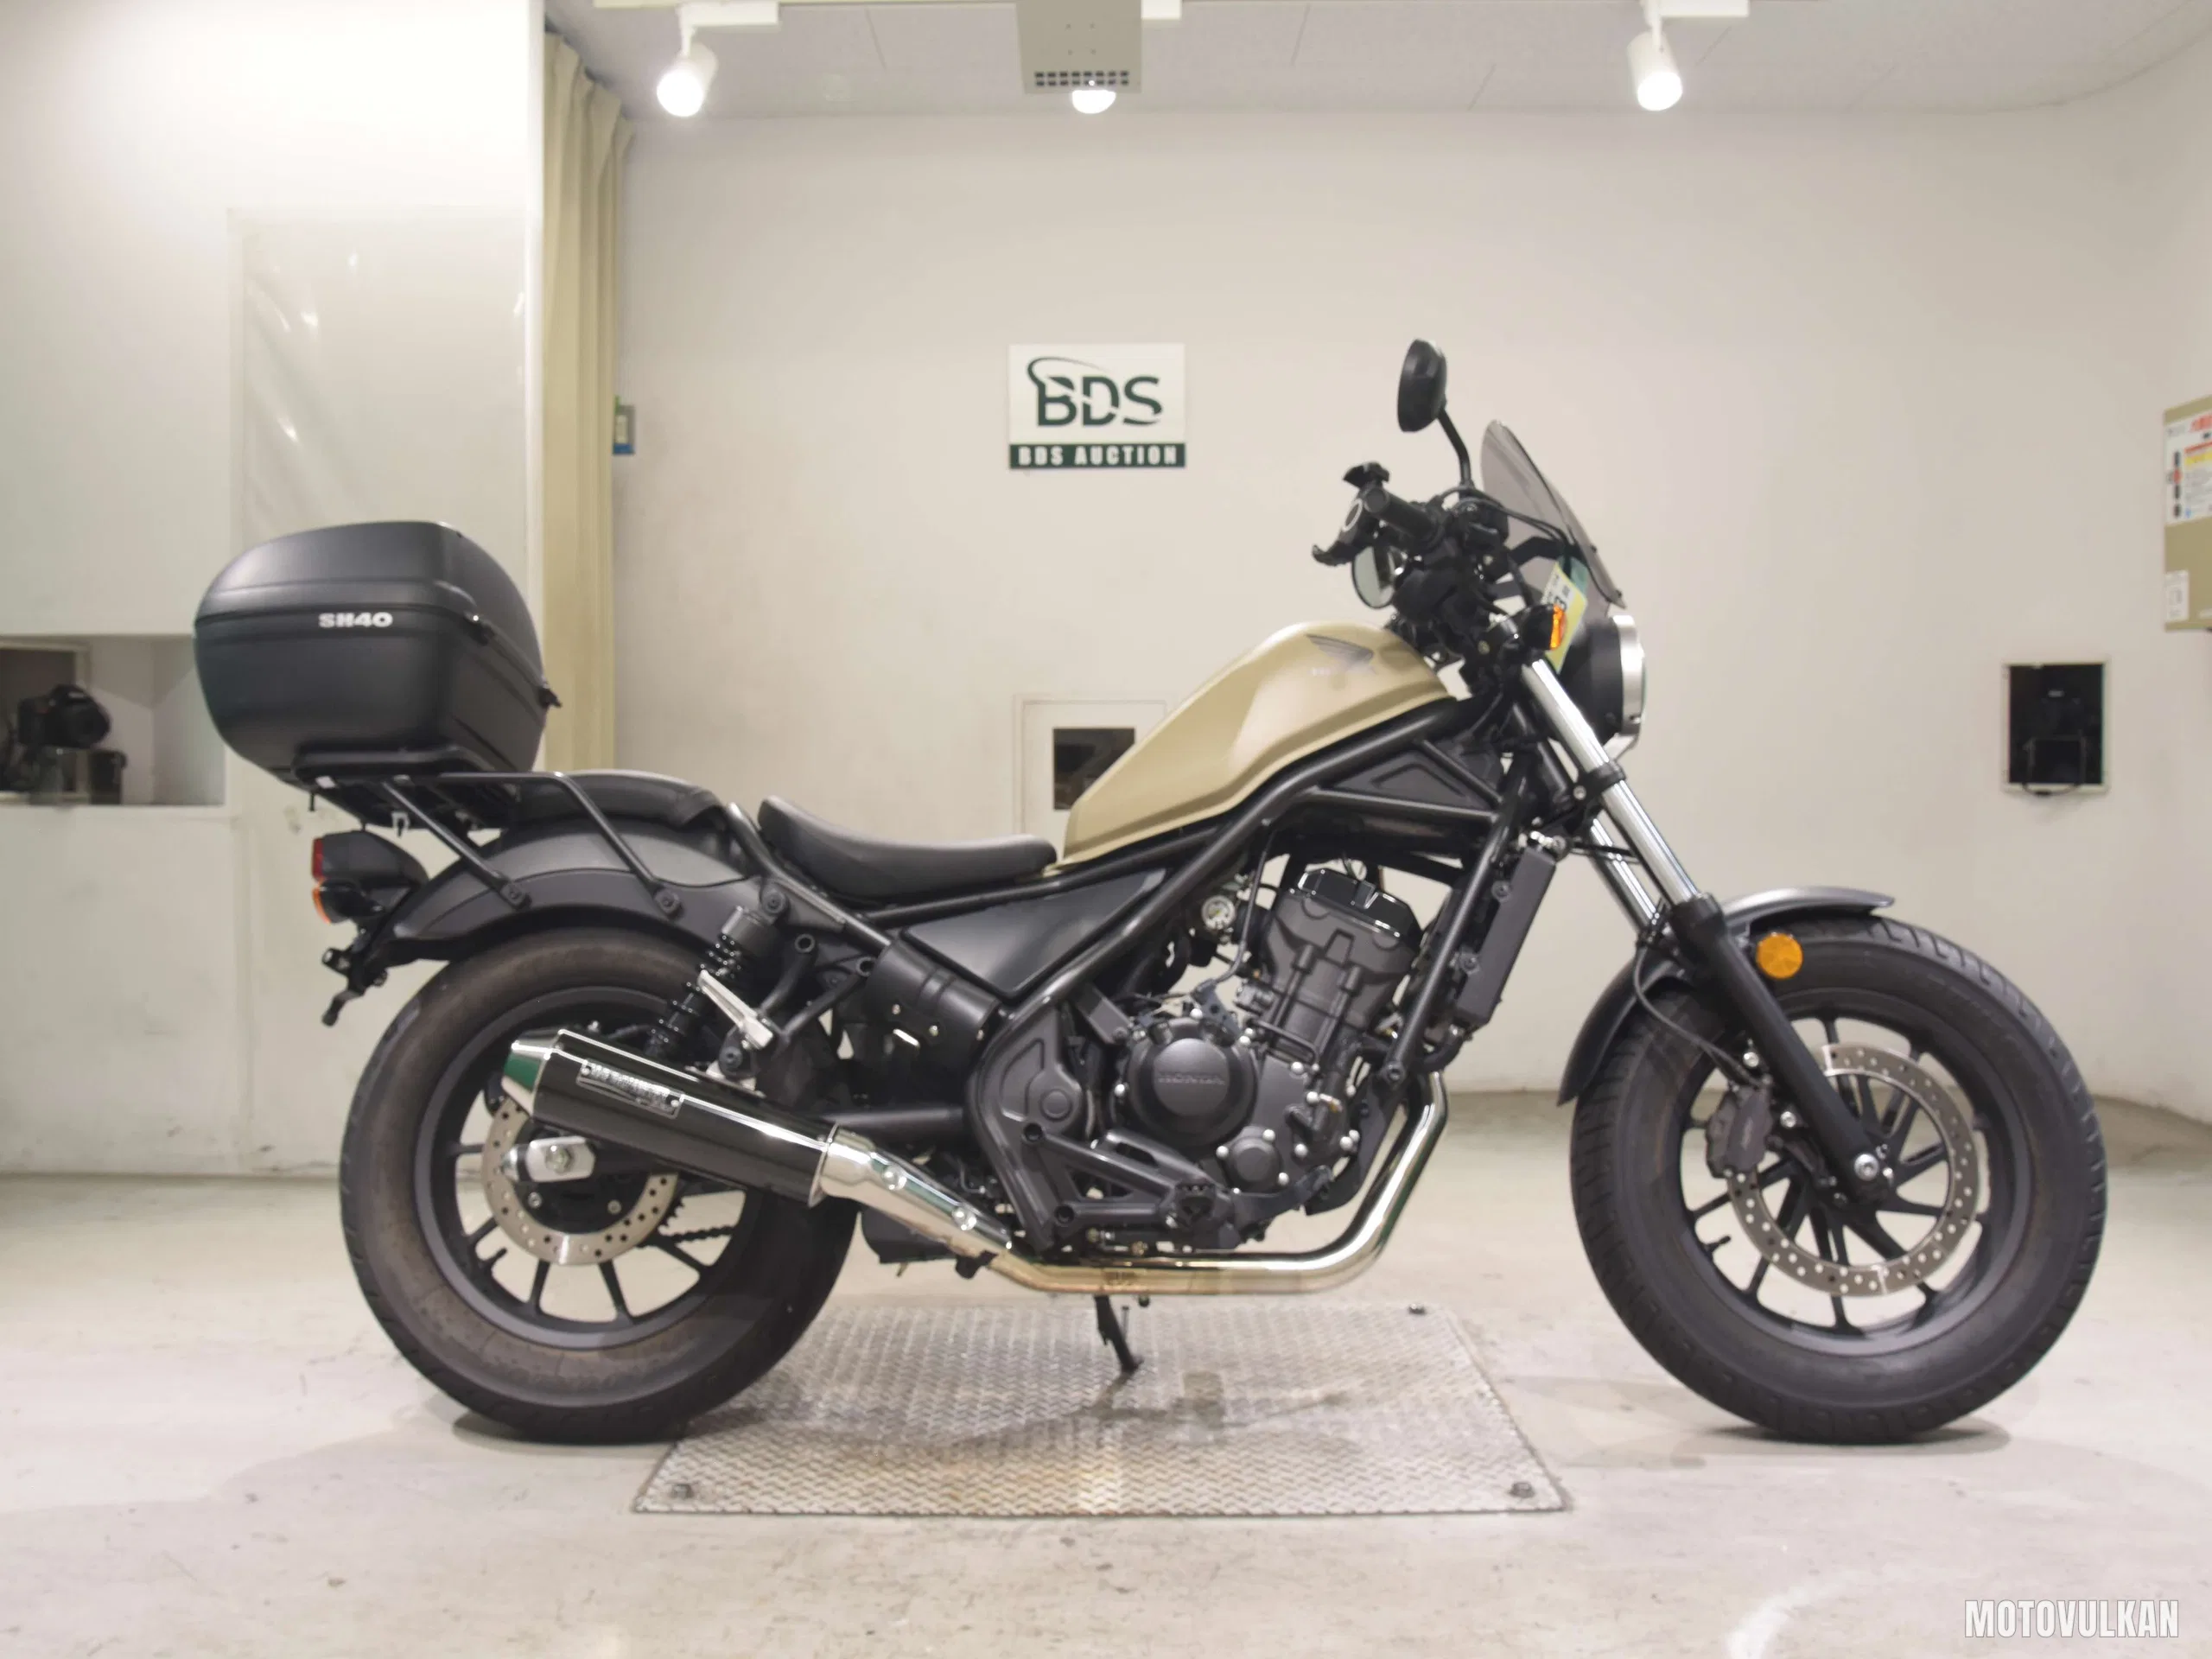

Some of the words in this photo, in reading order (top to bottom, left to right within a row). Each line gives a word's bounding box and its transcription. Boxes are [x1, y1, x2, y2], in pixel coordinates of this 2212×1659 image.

[1027, 356, 1163, 426] BDS
[1018, 445, 1064, 466] BDS
[1074, 444, 1178, 466] AUCTION
[318, 612, 393, 628] SH40
